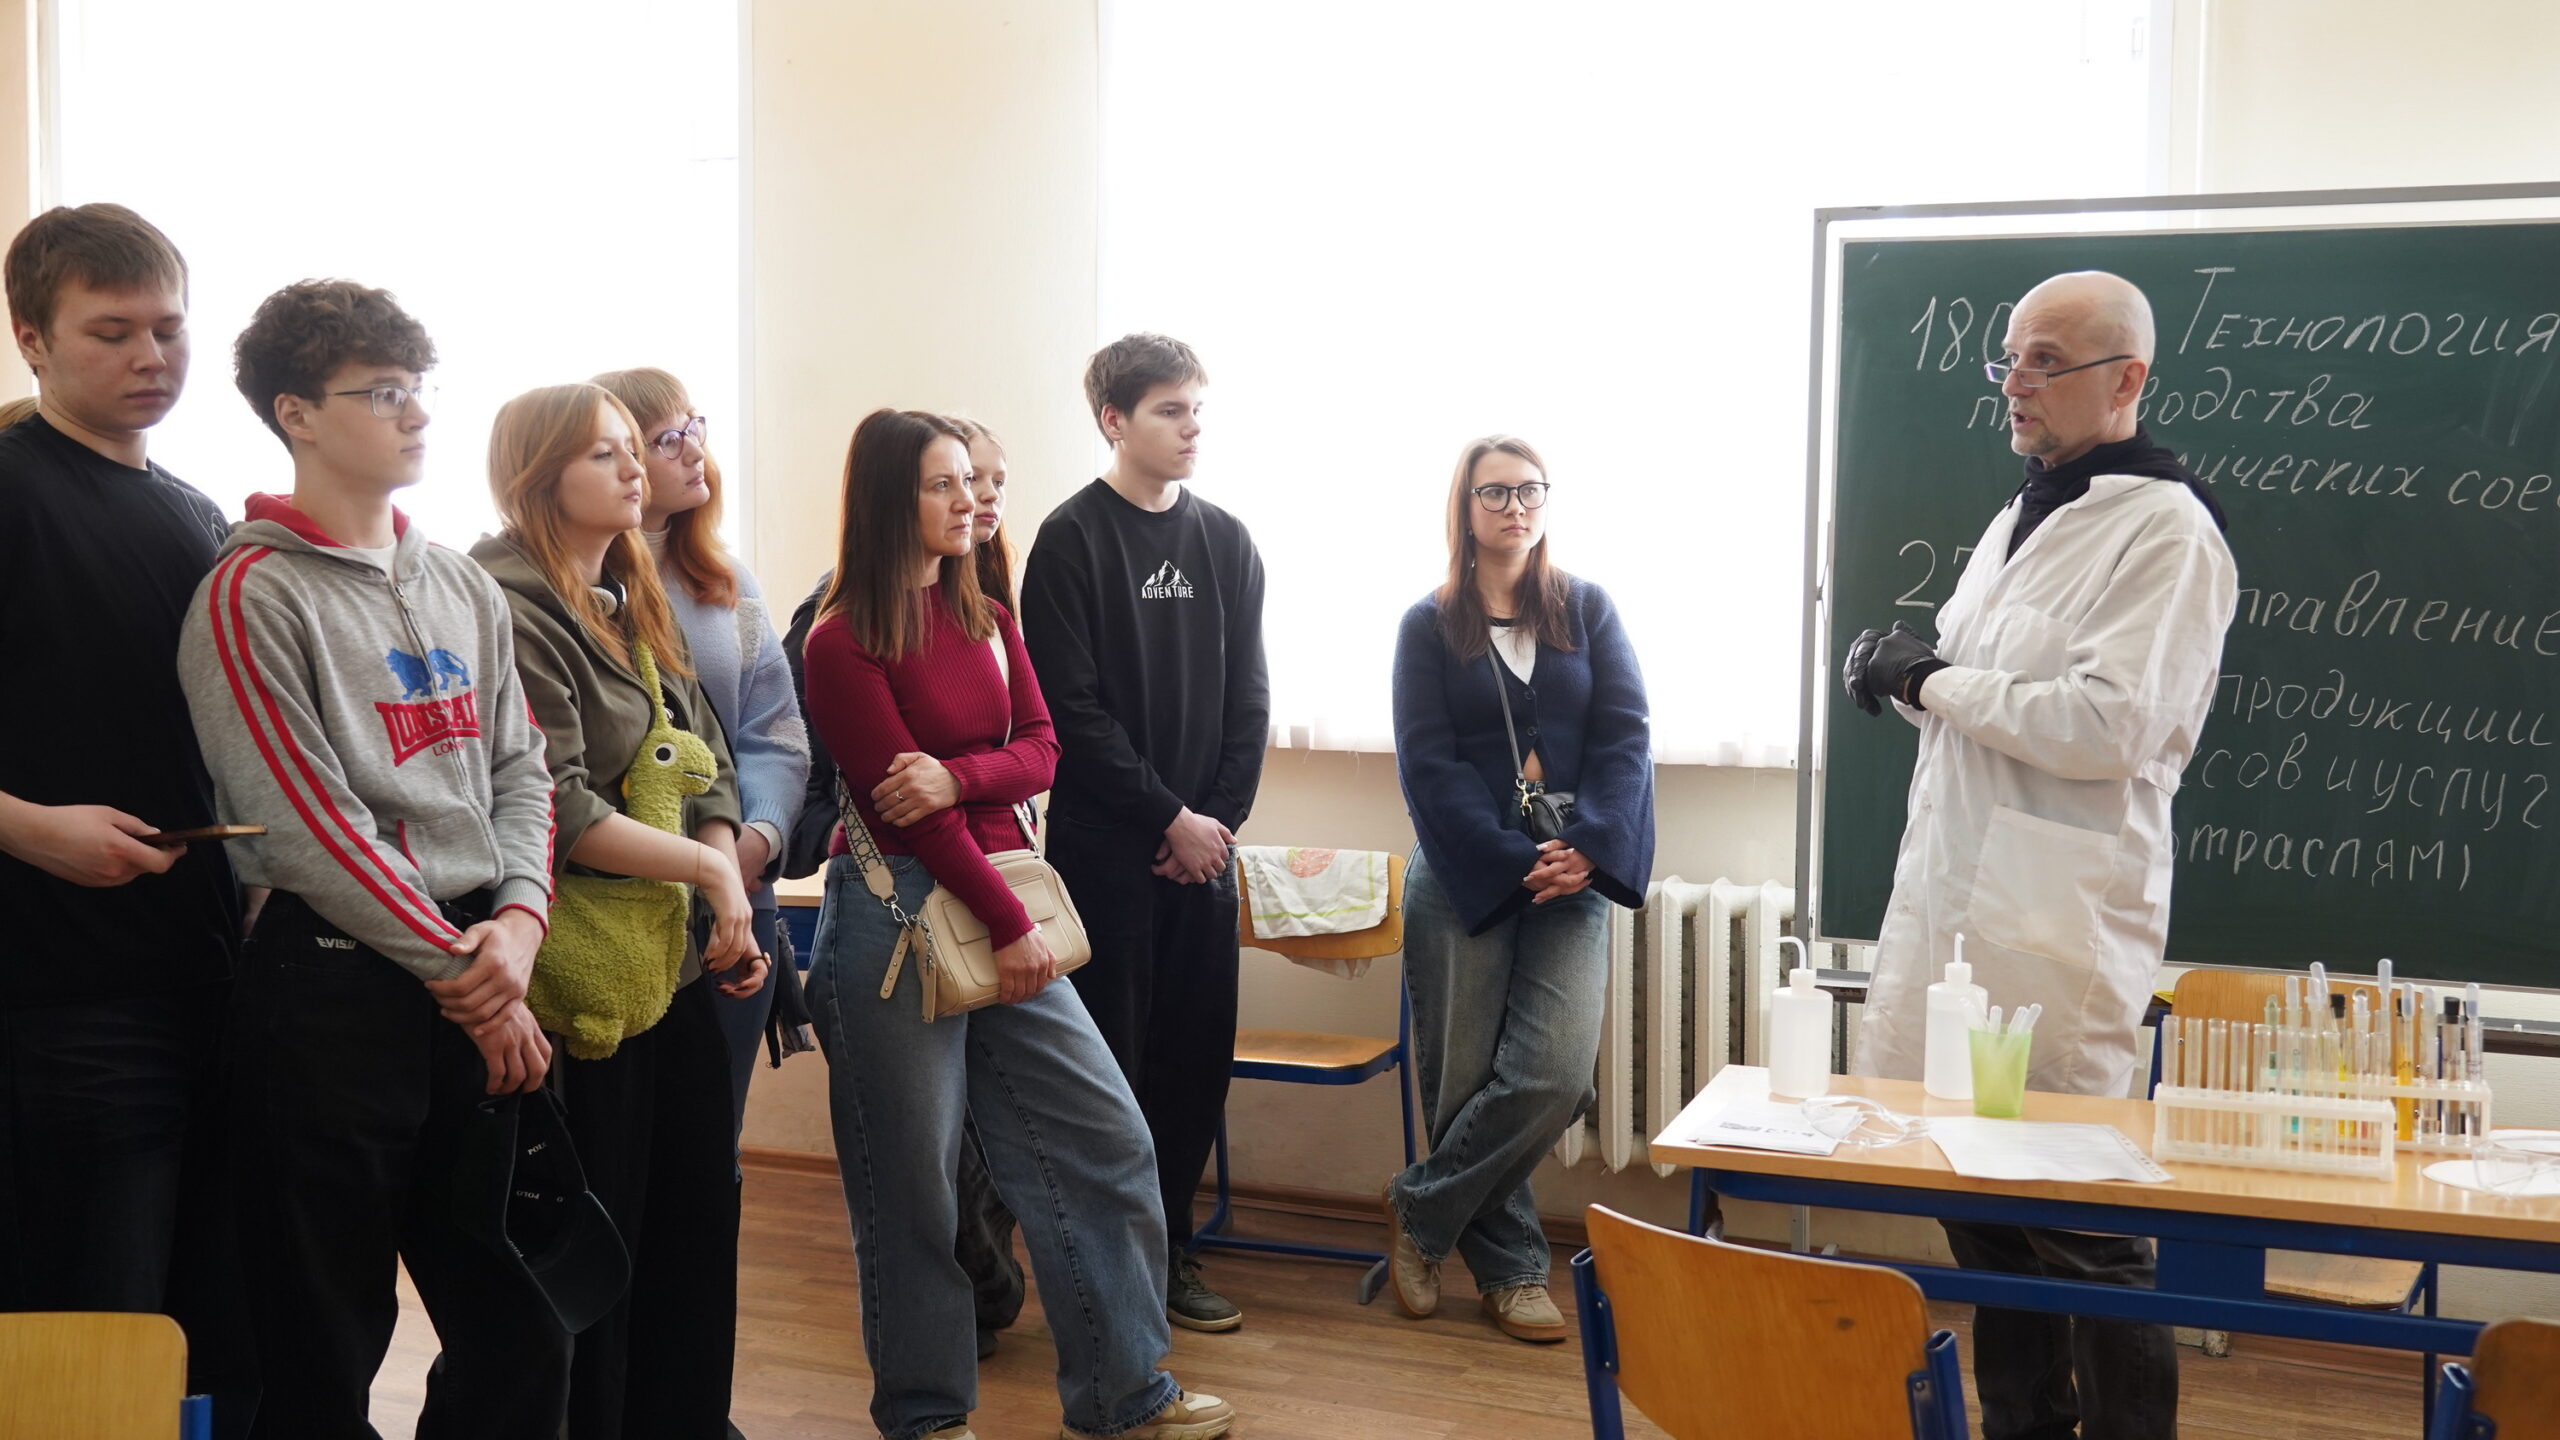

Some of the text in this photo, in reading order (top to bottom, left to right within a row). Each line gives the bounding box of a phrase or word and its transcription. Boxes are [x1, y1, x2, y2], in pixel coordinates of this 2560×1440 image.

[2178, 266, 2560, 357] Технология
[2447, 470, 2560, 511] сое
[1141, 586, 1194, 599] ADVENTURE
[2210, 669, 2552, 745] продукции
[2326, 756, 2358, 792] и
[2366, 758, 2549, 832] услуг
[315, 936, 357, 950] EVISU
